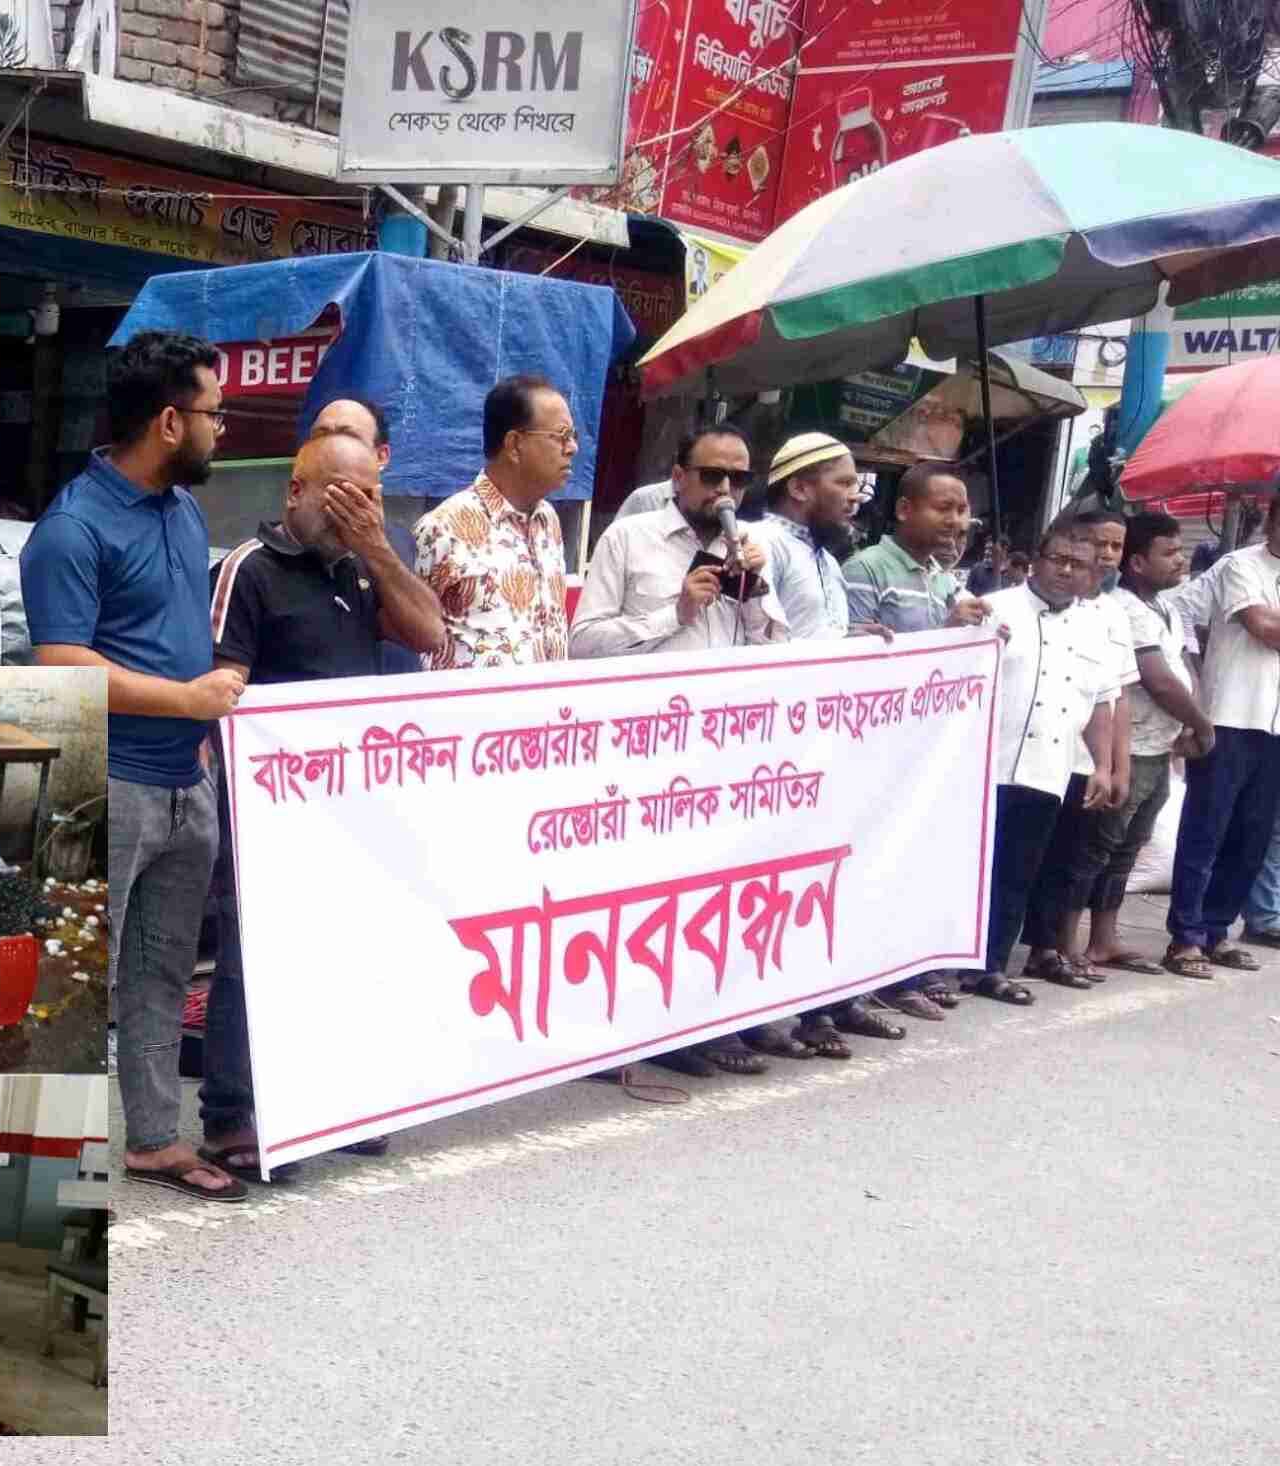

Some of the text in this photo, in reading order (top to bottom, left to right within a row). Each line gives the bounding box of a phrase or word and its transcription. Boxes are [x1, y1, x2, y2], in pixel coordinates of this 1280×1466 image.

[391, 27, 583, 99] KSRM
[389, 106, 575, 136] শেকড় থেকে শিখরে
[241, 344, 328, 386] BEE
[1183, 327, 1280, 355] WALT
[248, 742, 350, 806] বাংলা
[358, 722, 463, 792] টিফিন
[470, 706, 604, 778] রেস্তোরাঁয়
[702, 697, 780, 750] হামলা
[787, 700, 807, 735] ও
[815, 687, 907, 743] ভাংচুরের
[527, 760, 825, 854] রেস্তোরাঁ মালিক সমিতির
[447, 844, 852, 1042] মানববন্ধন
